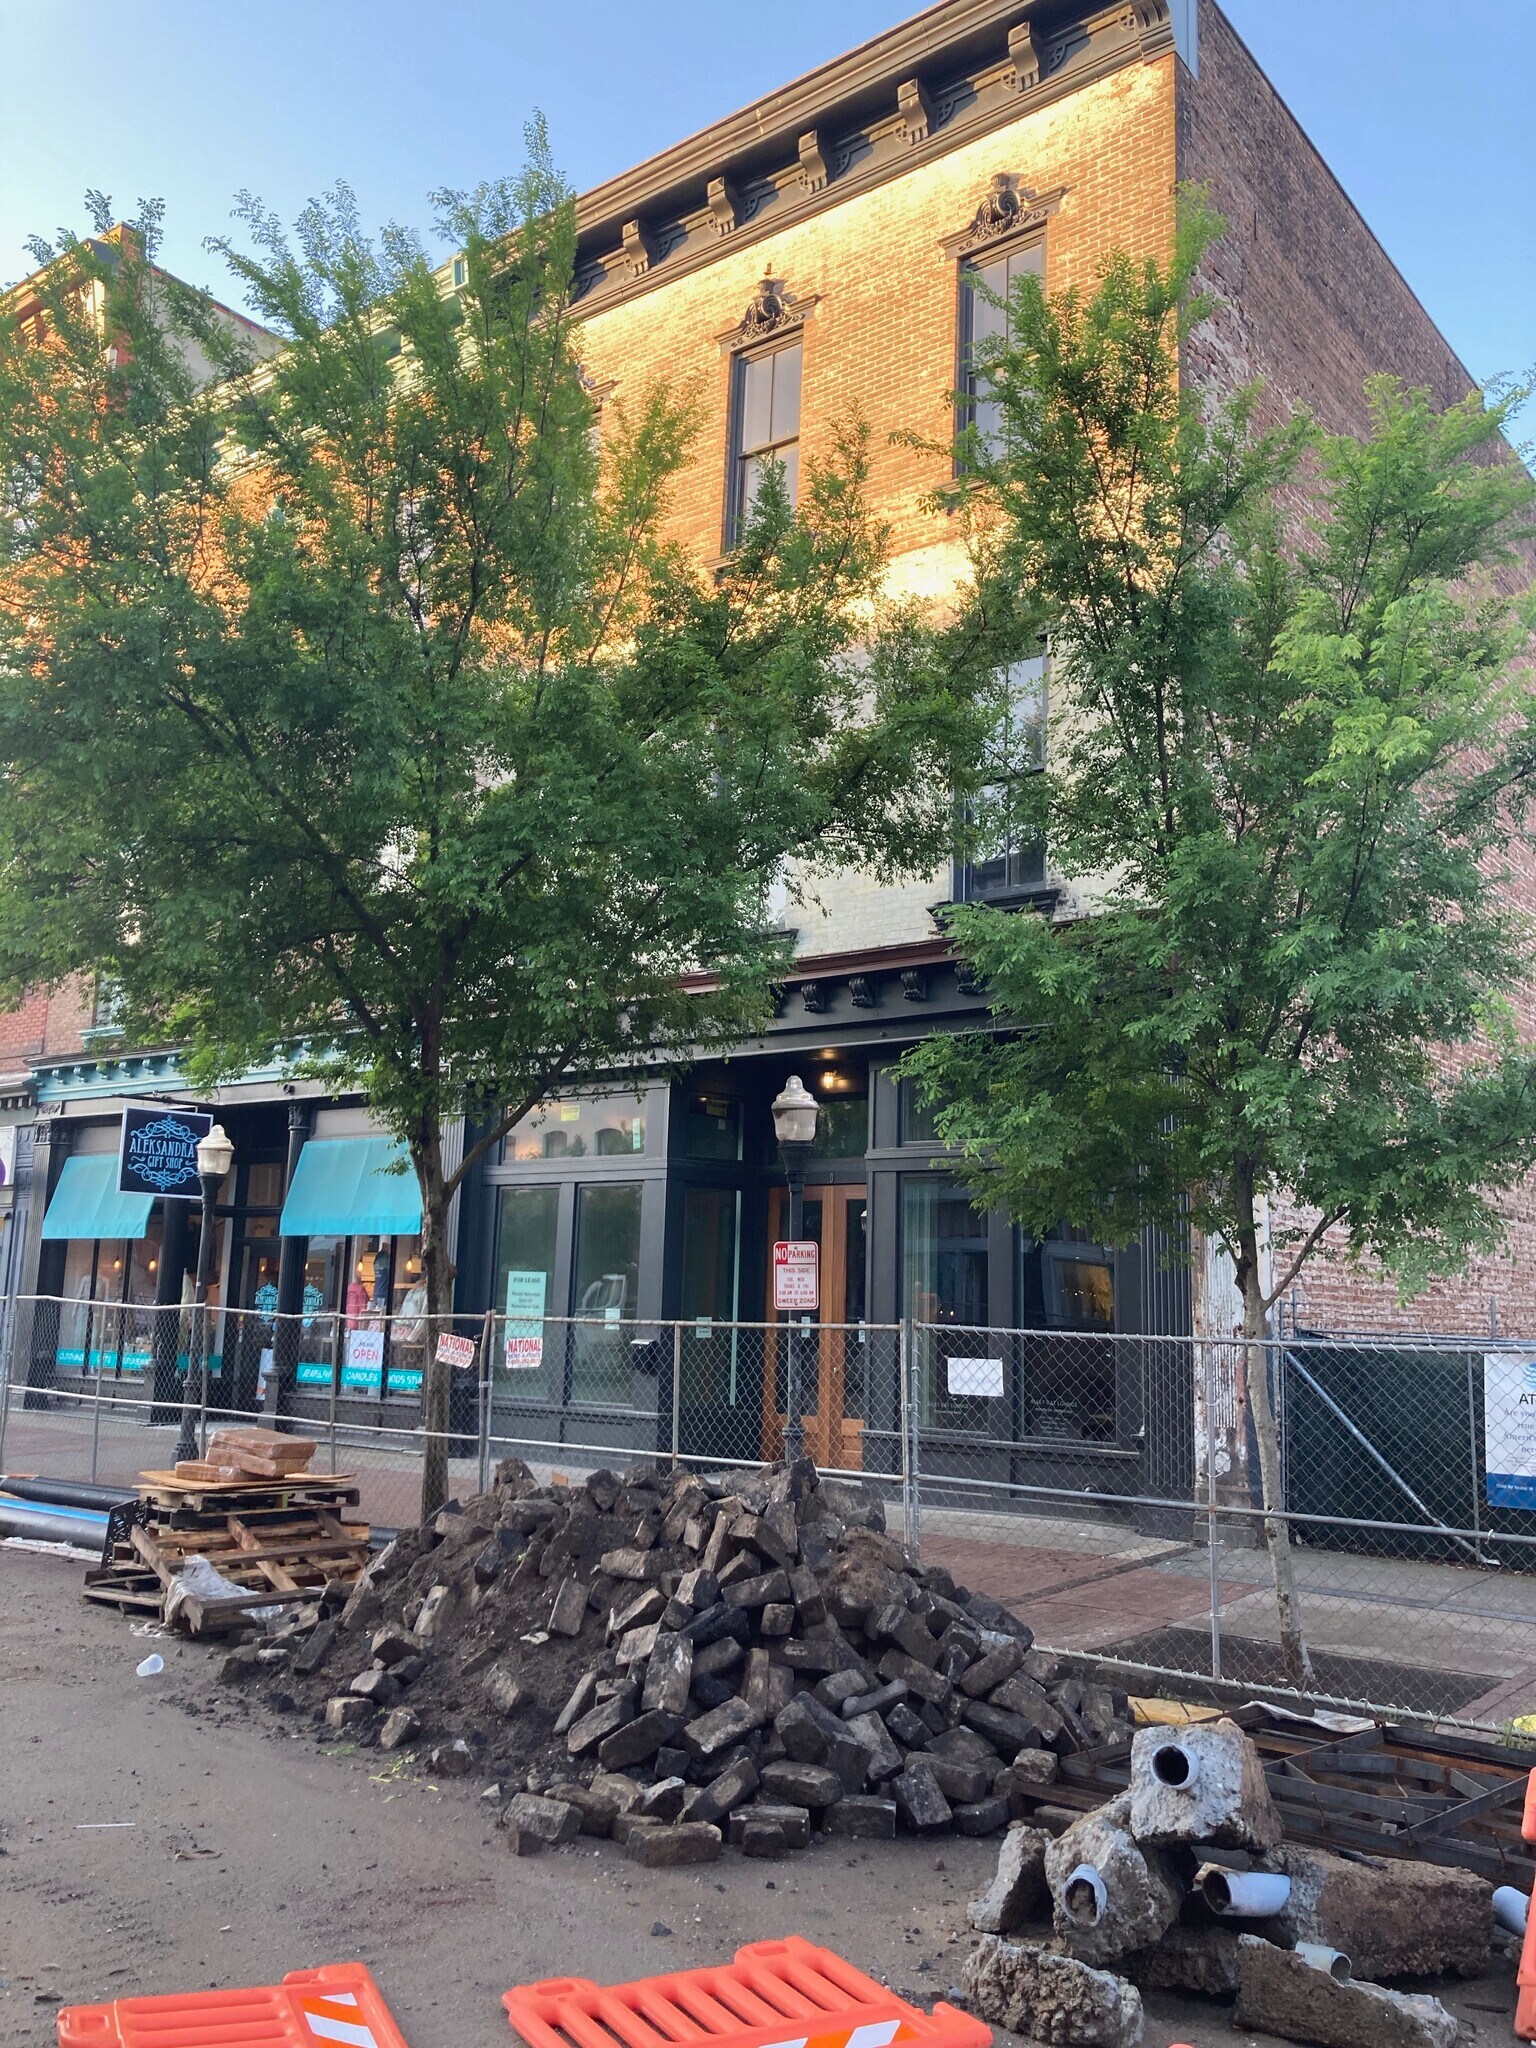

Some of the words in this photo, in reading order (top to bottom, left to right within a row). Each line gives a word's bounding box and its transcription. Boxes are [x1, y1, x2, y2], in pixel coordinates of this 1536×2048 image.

[147, 1155, 164, 1168] GIFT
[165, 1157, 183, 1169] SHOP
[775, 1247, 787, 1260] NO
[789, 1250, 815, 1259] PARKING
[440, 1334, 473, 1354] NATIONAL
[508, 1339, 541, 1352] NATIONAL
[353, 1349, 379, 1360] OPEN
[346, 1371, 378, 1382] CANDLES
[388, 1374, 405, 1384] KIDS
[1504, 1408, 1518, 1417] Are
